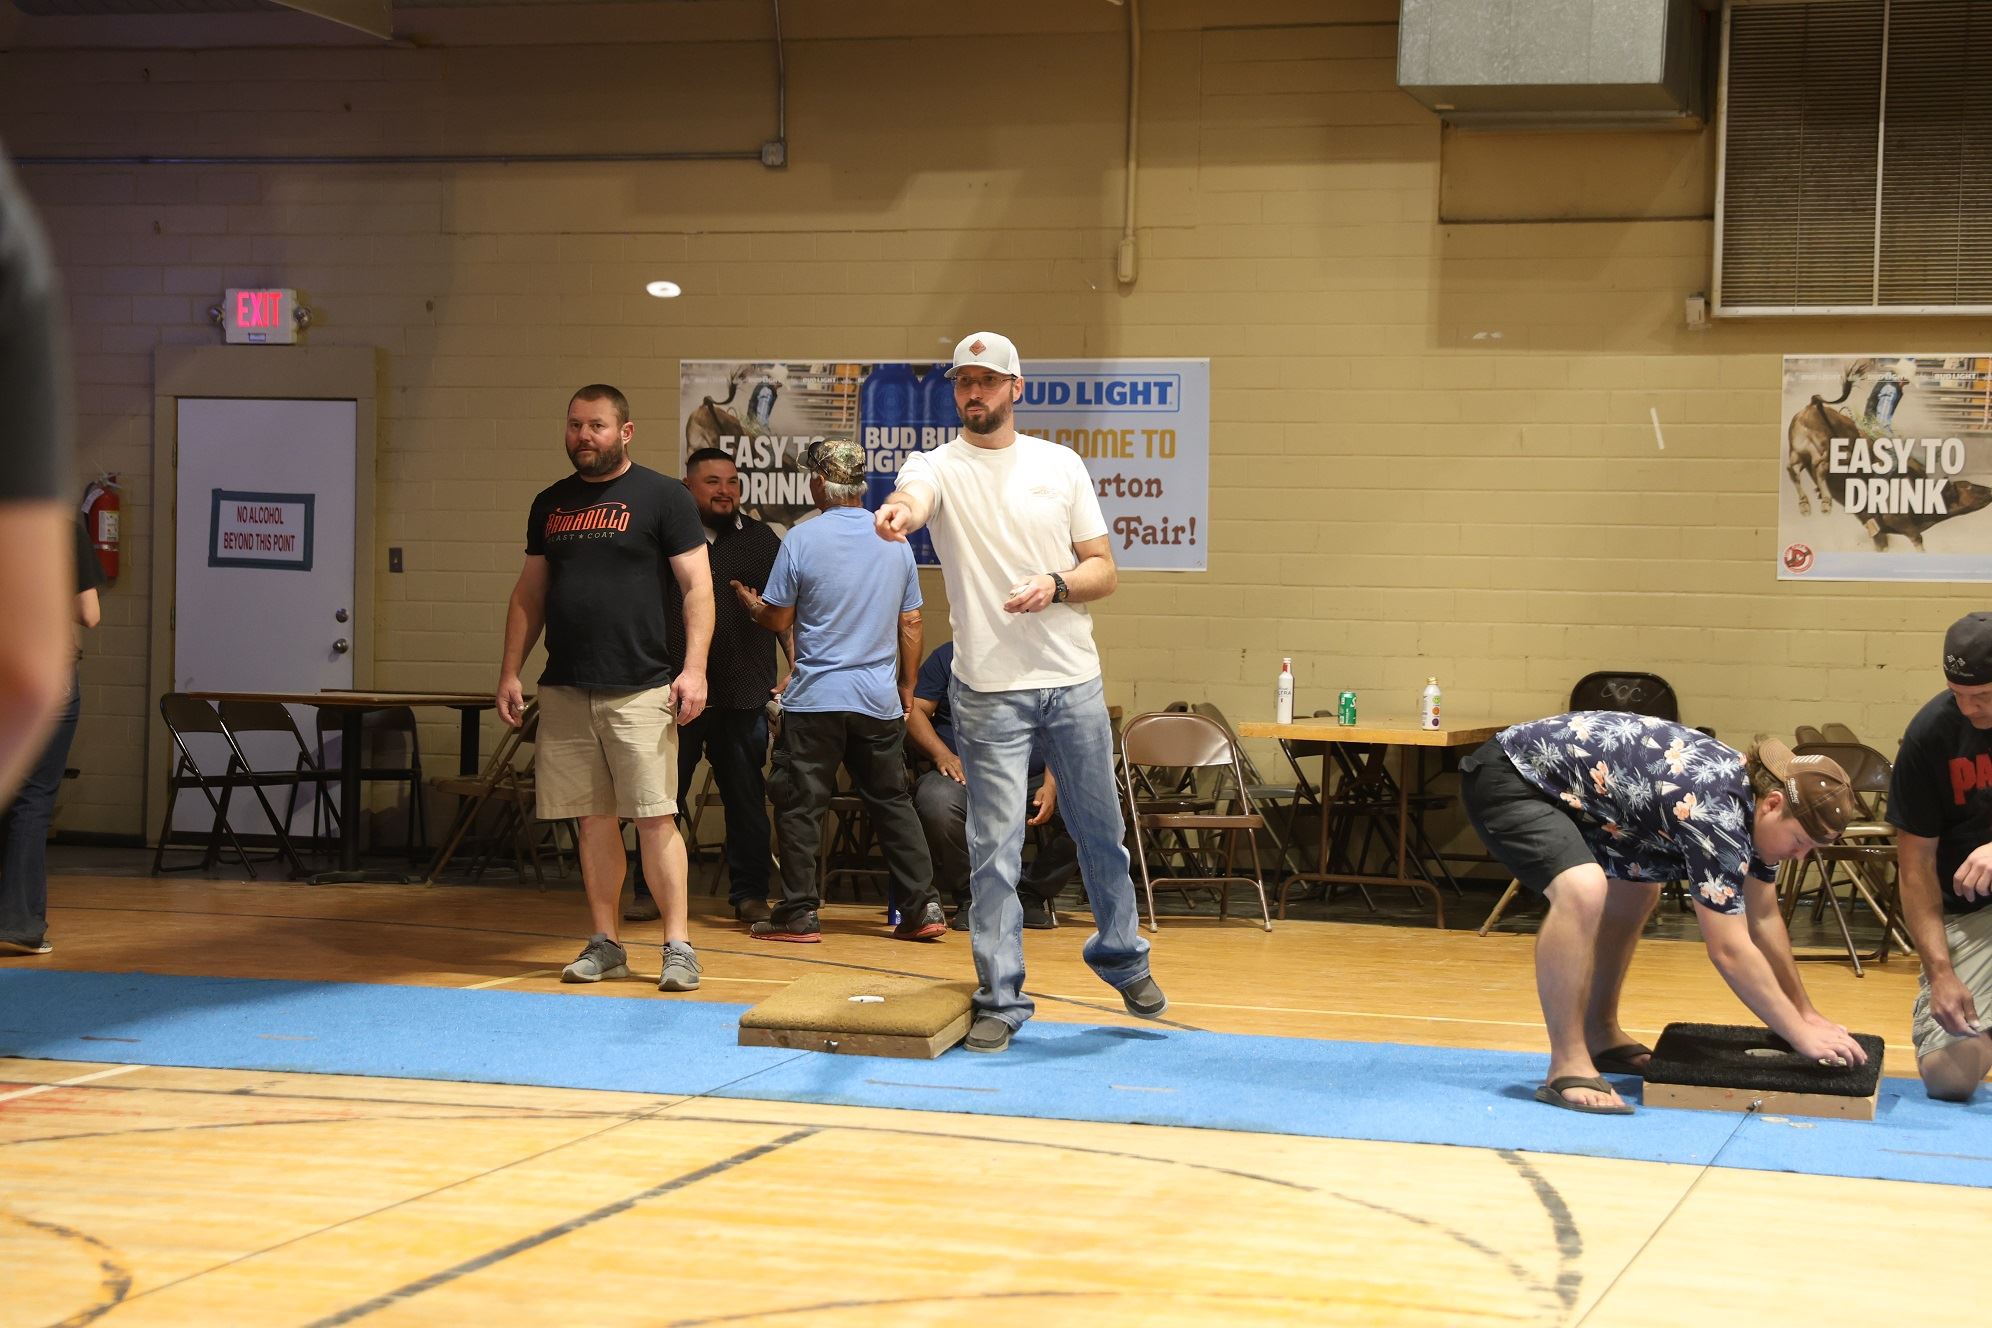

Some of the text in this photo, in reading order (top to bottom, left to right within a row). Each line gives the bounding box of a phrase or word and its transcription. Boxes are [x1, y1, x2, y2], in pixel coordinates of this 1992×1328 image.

[236, 290, 282, 328] EXIT
[1013, 381, 1173, 405] UD LIGHT
[719, 435, 826, 469] EASY T
[864, 427, 917, 450] BUD
[1141, 428, 1177, 459] TO
[1829, 437, 1966, 475] EASY TO
[1092, 473, 1164, 499] rton
[1844, 478, 1949, 514] DRINK
[236, 505, 284, 525] NO ALCOHOL
[545, 508, 631, 537] ARMADILLO
[223, 533, 295, 552] BEYOND THIS POINT
[587, 531, 614, 539] COAT
[1113, 516, 1197, 550] Fair!
